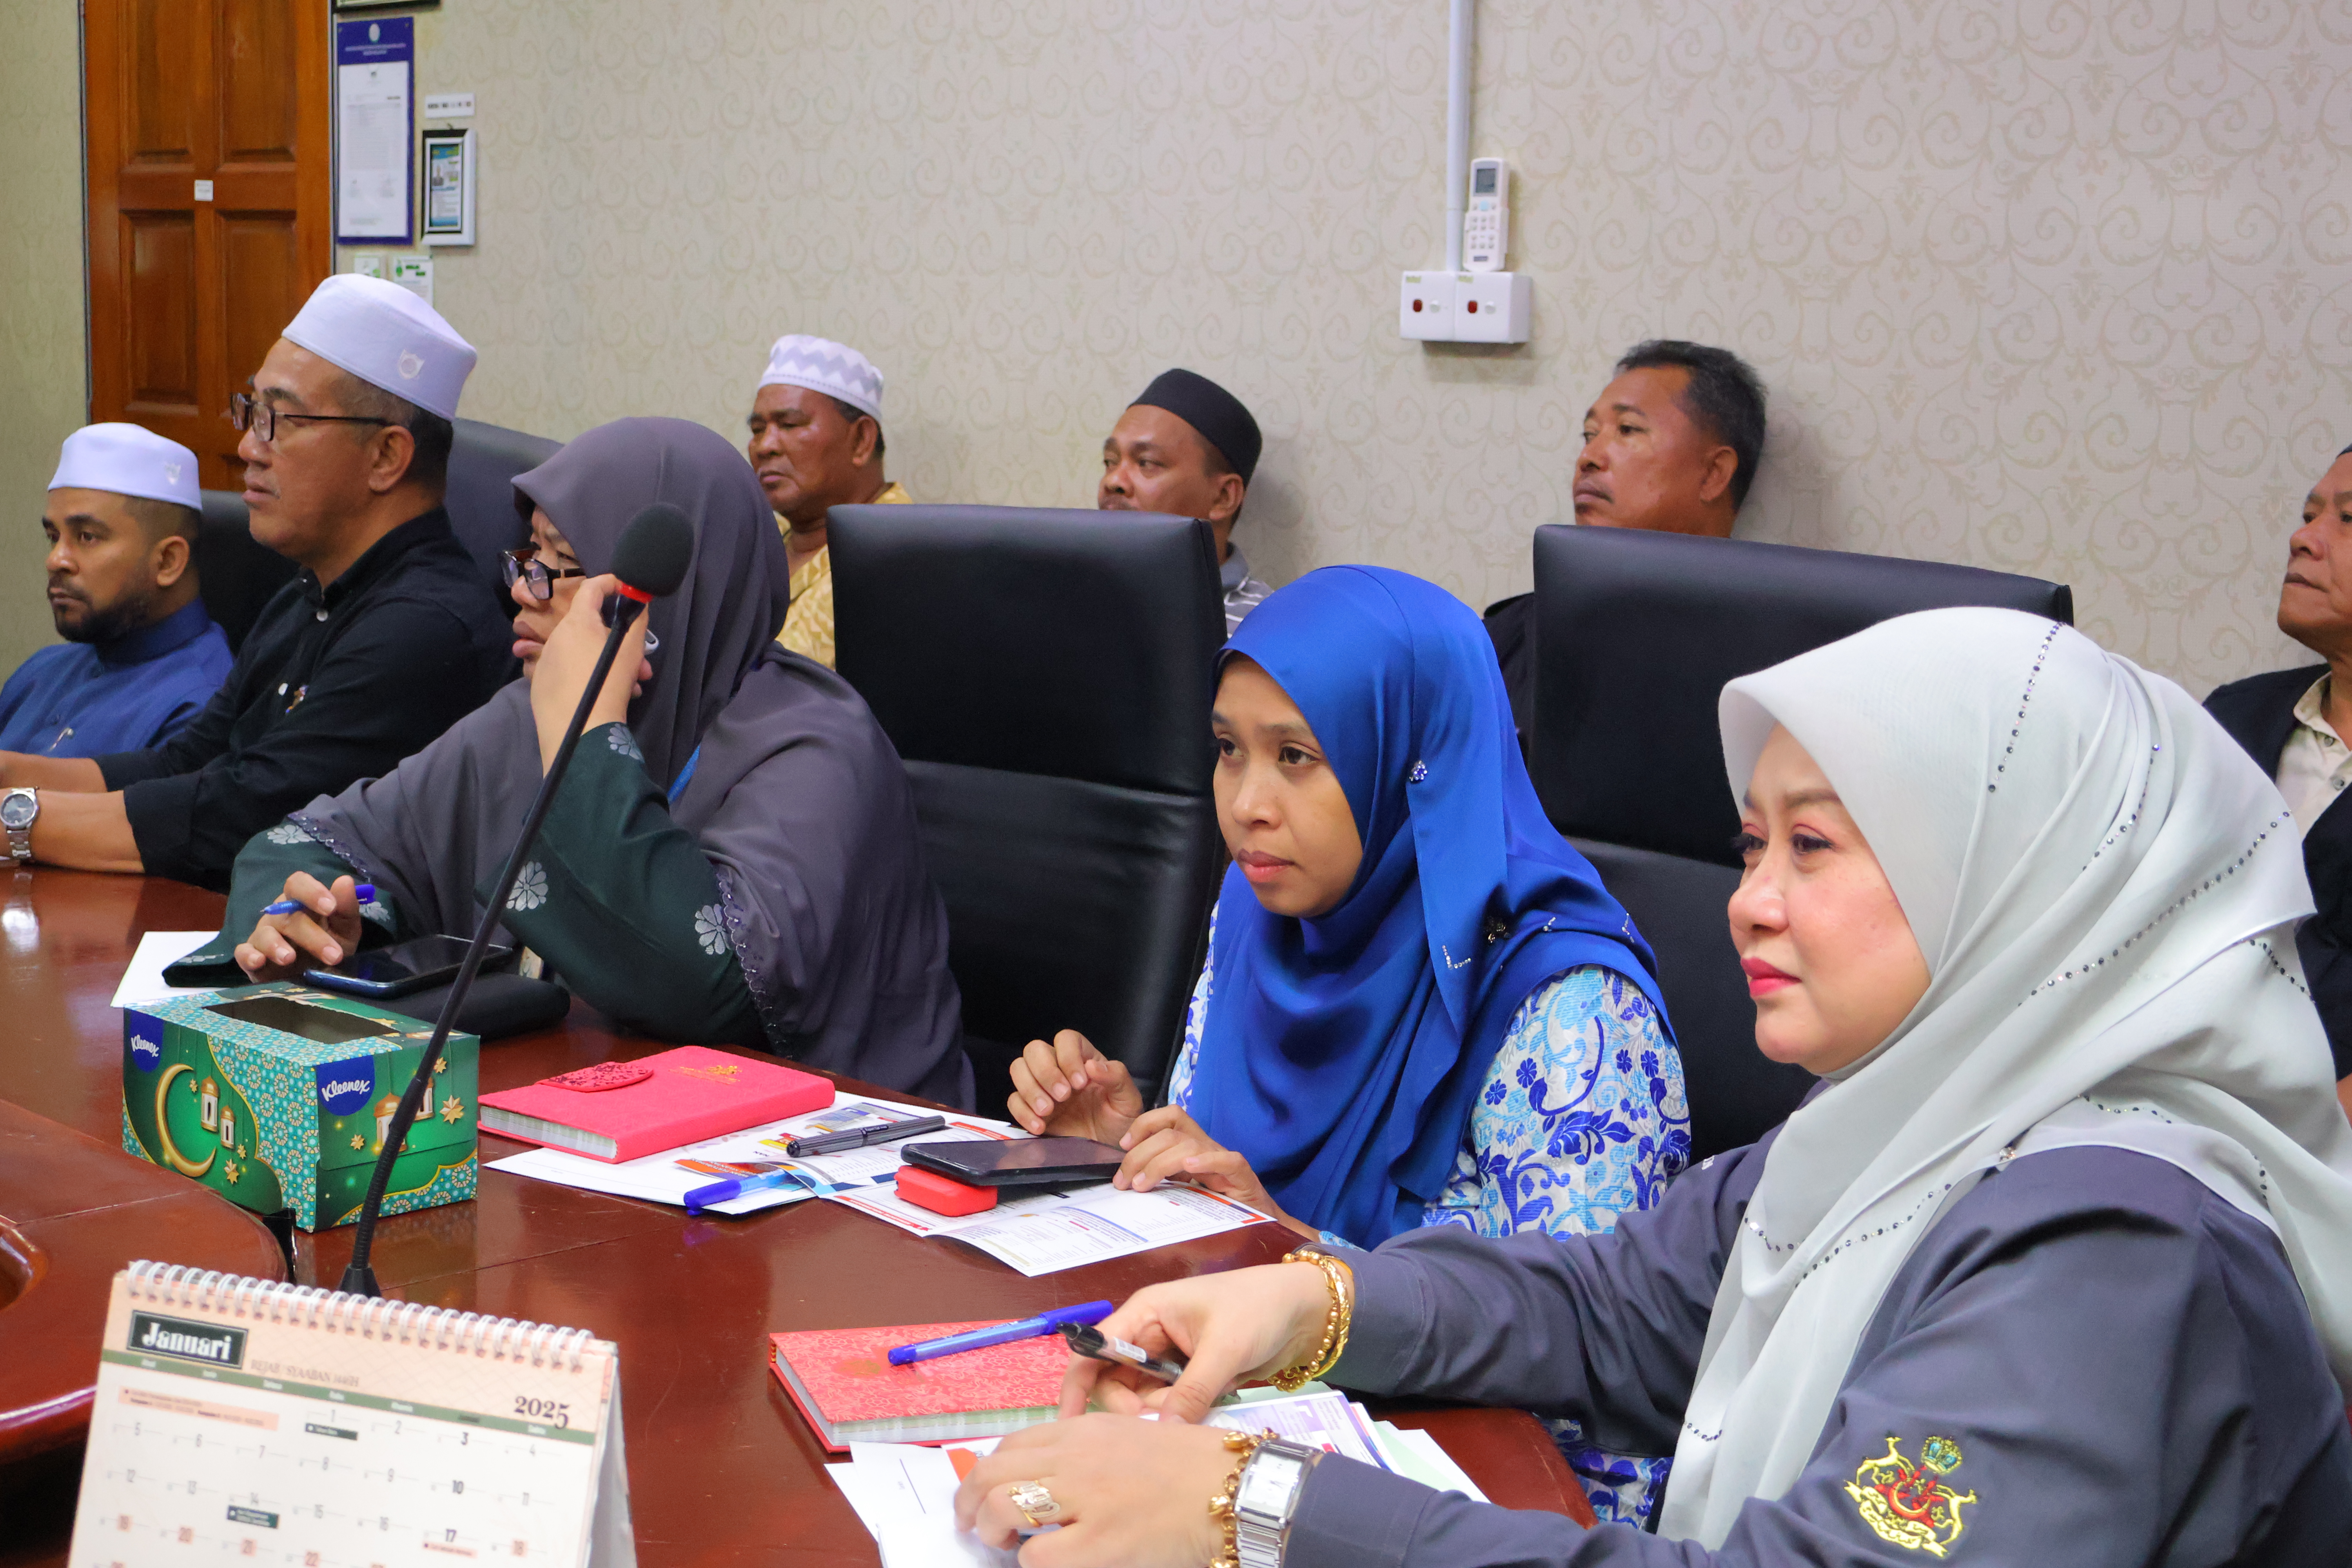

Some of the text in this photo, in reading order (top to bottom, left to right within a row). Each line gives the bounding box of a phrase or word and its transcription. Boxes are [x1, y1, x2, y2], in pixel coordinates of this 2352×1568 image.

[131, 1034, 160, 1057] Kleenex
[321, 1080, 370, 1102] Kleenex
[142, 1322, 232, 1360] Januari
[514, 1396, 569, 1430] 2025
[395, 1420, 402, 1435] 2
[461, 1432, 469, 1446] 3
[195, 1433, 203, 1447] 6
[259, 1444, 266, 1459] 7
[322, 1456, 329, 1470] 8
[387, 1468, 394, 1483] 9
[452, 1480, 464, 1495] 10
[446, 1528, 457, 1543] 17
